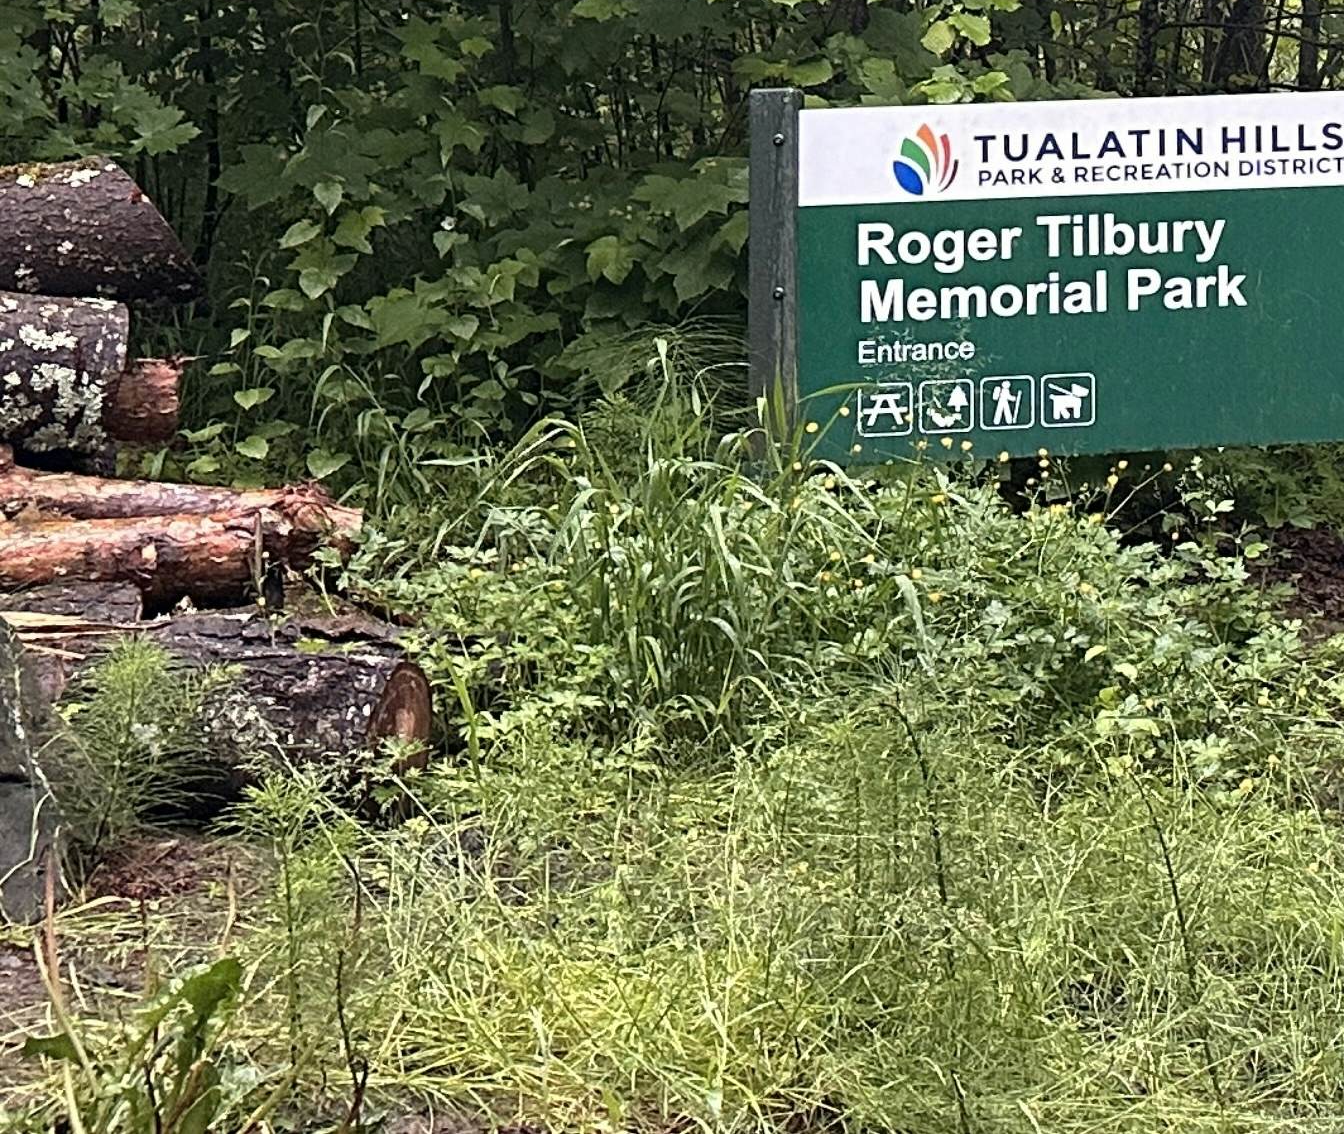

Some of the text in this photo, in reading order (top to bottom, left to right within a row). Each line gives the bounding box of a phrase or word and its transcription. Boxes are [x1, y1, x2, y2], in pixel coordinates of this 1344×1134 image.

[973, 122, 1344, 164] TUALATIN HILLS
[978, 167, 1044, 186] PARK
[1051, 167, 1066, 184] &
[1074, 161, 1230, 183] RECREATION
[857, 213, 1226, 274] Roger Tilbury
[860, 264, 1248, 323] Memorial Park
[858, 339, 976, 364] Entrance
